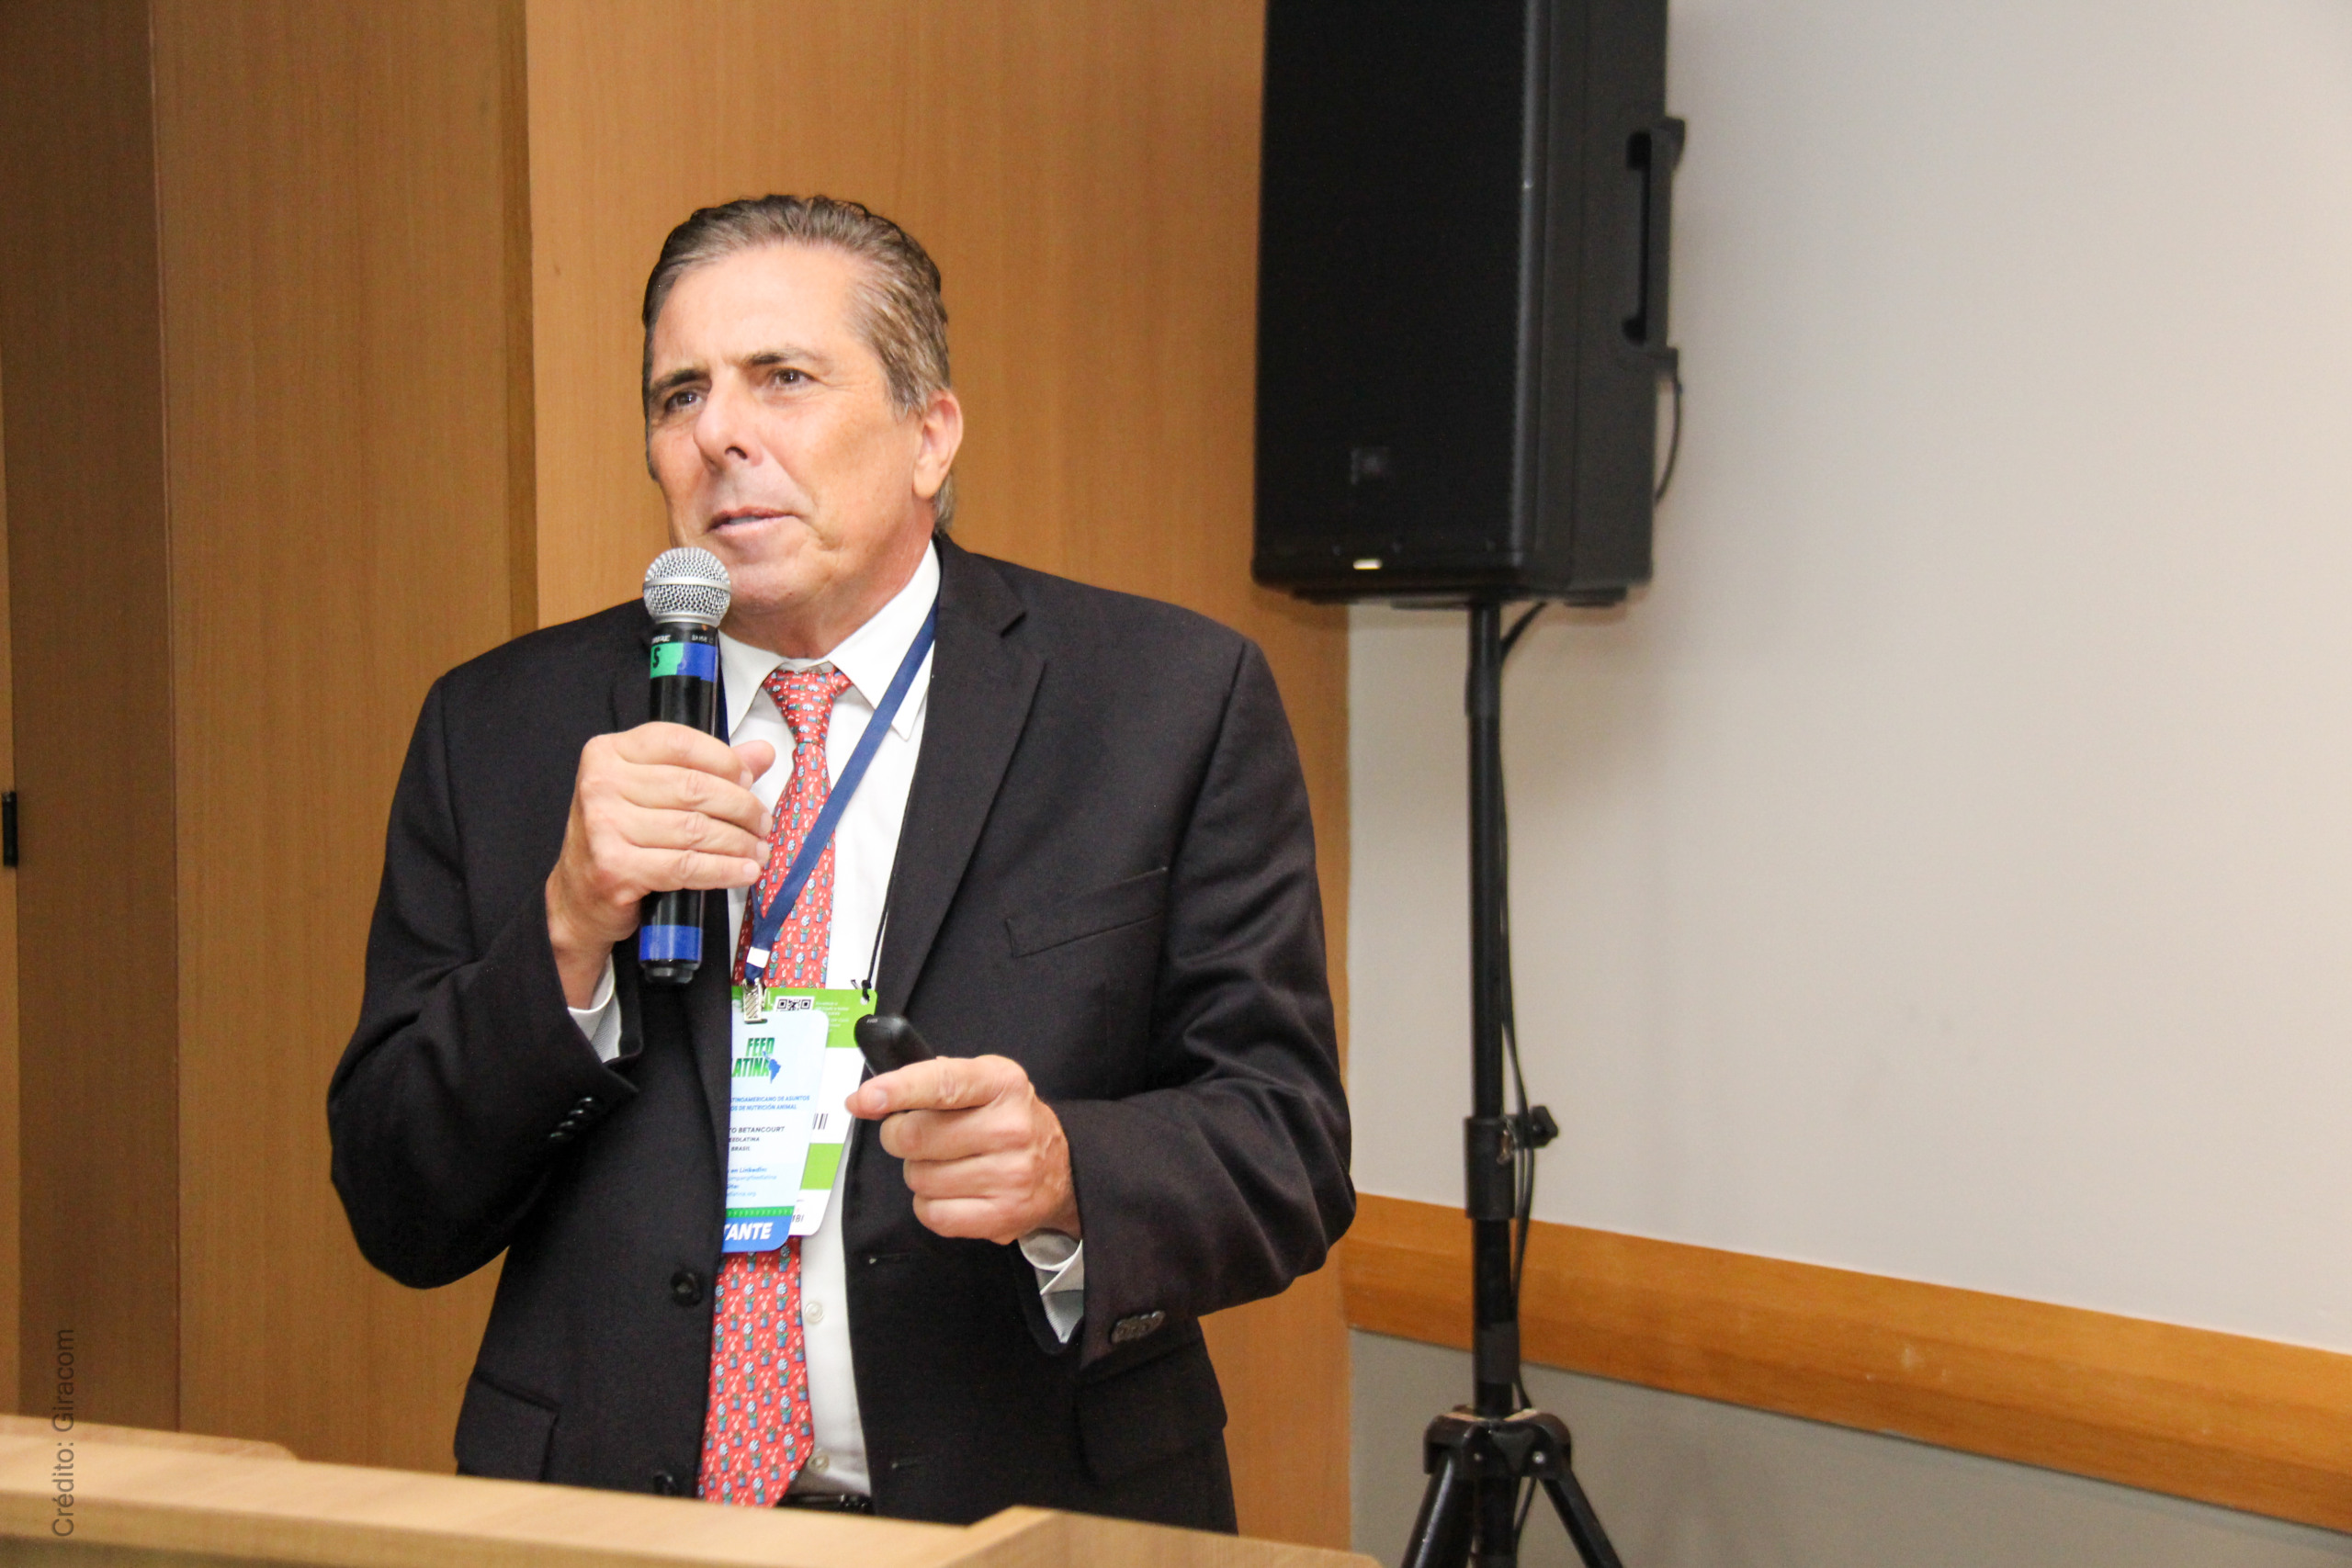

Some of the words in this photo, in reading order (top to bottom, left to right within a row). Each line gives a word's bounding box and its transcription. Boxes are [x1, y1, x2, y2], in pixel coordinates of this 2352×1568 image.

[745, 1037, 775, 1057] FEED
[731, 1057, 770, 1077] ATINA
[724, 1222, 774, 1241] TANTE
